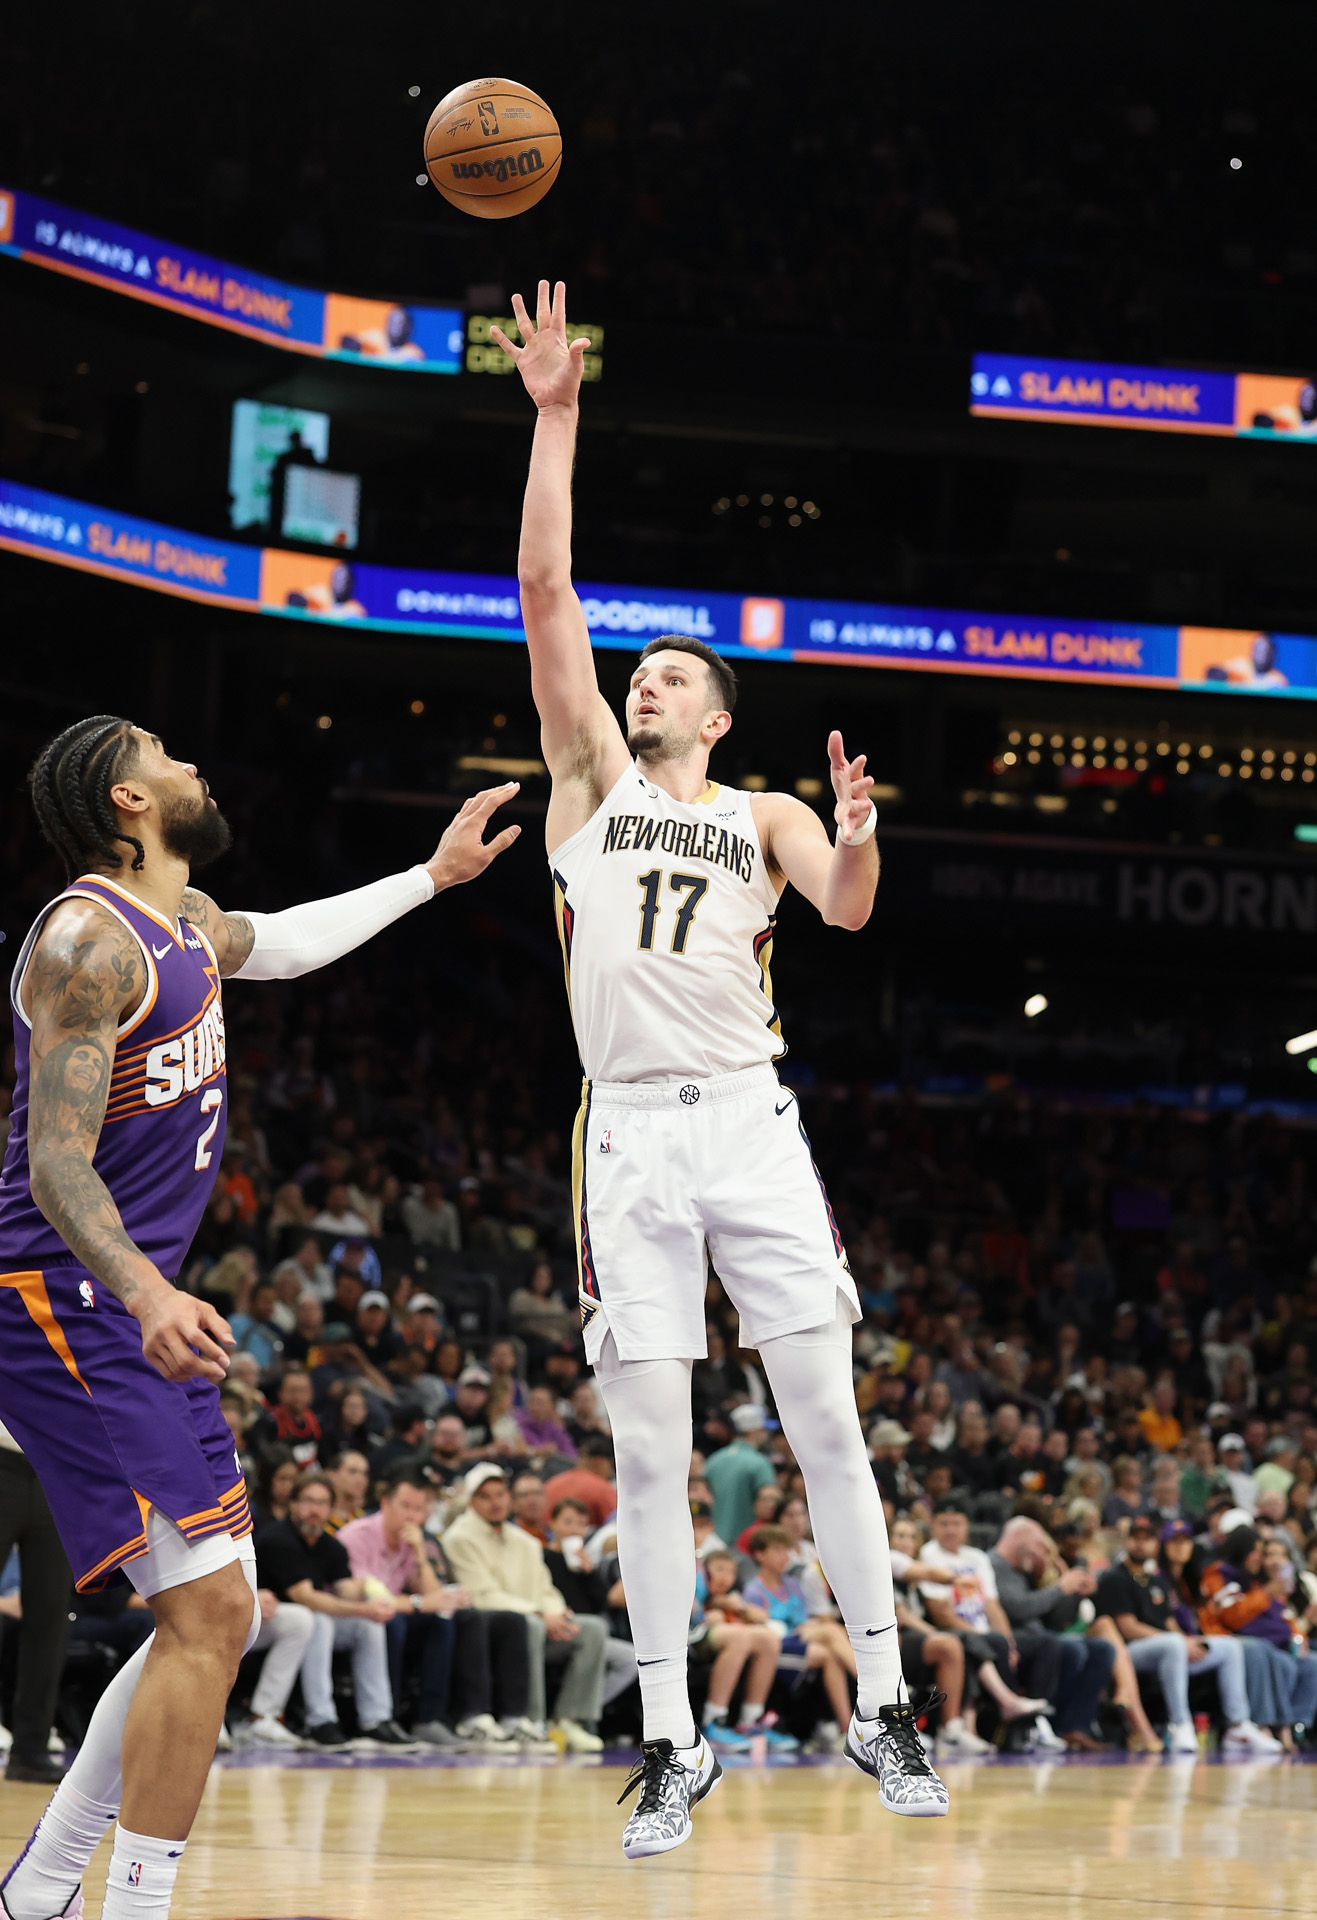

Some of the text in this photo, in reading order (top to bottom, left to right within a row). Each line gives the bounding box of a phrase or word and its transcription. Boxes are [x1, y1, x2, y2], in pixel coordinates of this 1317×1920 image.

[451, 147, 544, 182] Wilson
[35, 220, 58, 246] IS
[134, 256, 151, 279] A
[156, 256, 221, 304] SLAM
[222, 279, 292, 329] DUNK
[991, 375, 1012, 398] A
[1019, 371, 1104, 407] SLAM
[1107, 378, 1200, 415] DUNK
[65, 522, 83, 546] A
[87, 522, 152, 567] SLAM
[154, 540, 227, 587] DUNK
[580, 598, 716, 637] OODWILL
[810, 618, 1143, 668] IS ALWAYS A SLAM DUNK
[637, 868, 709, 955] 17
[1116, 863, 1317, 930] HORN
[194, 1088, 223, 1171] 2
